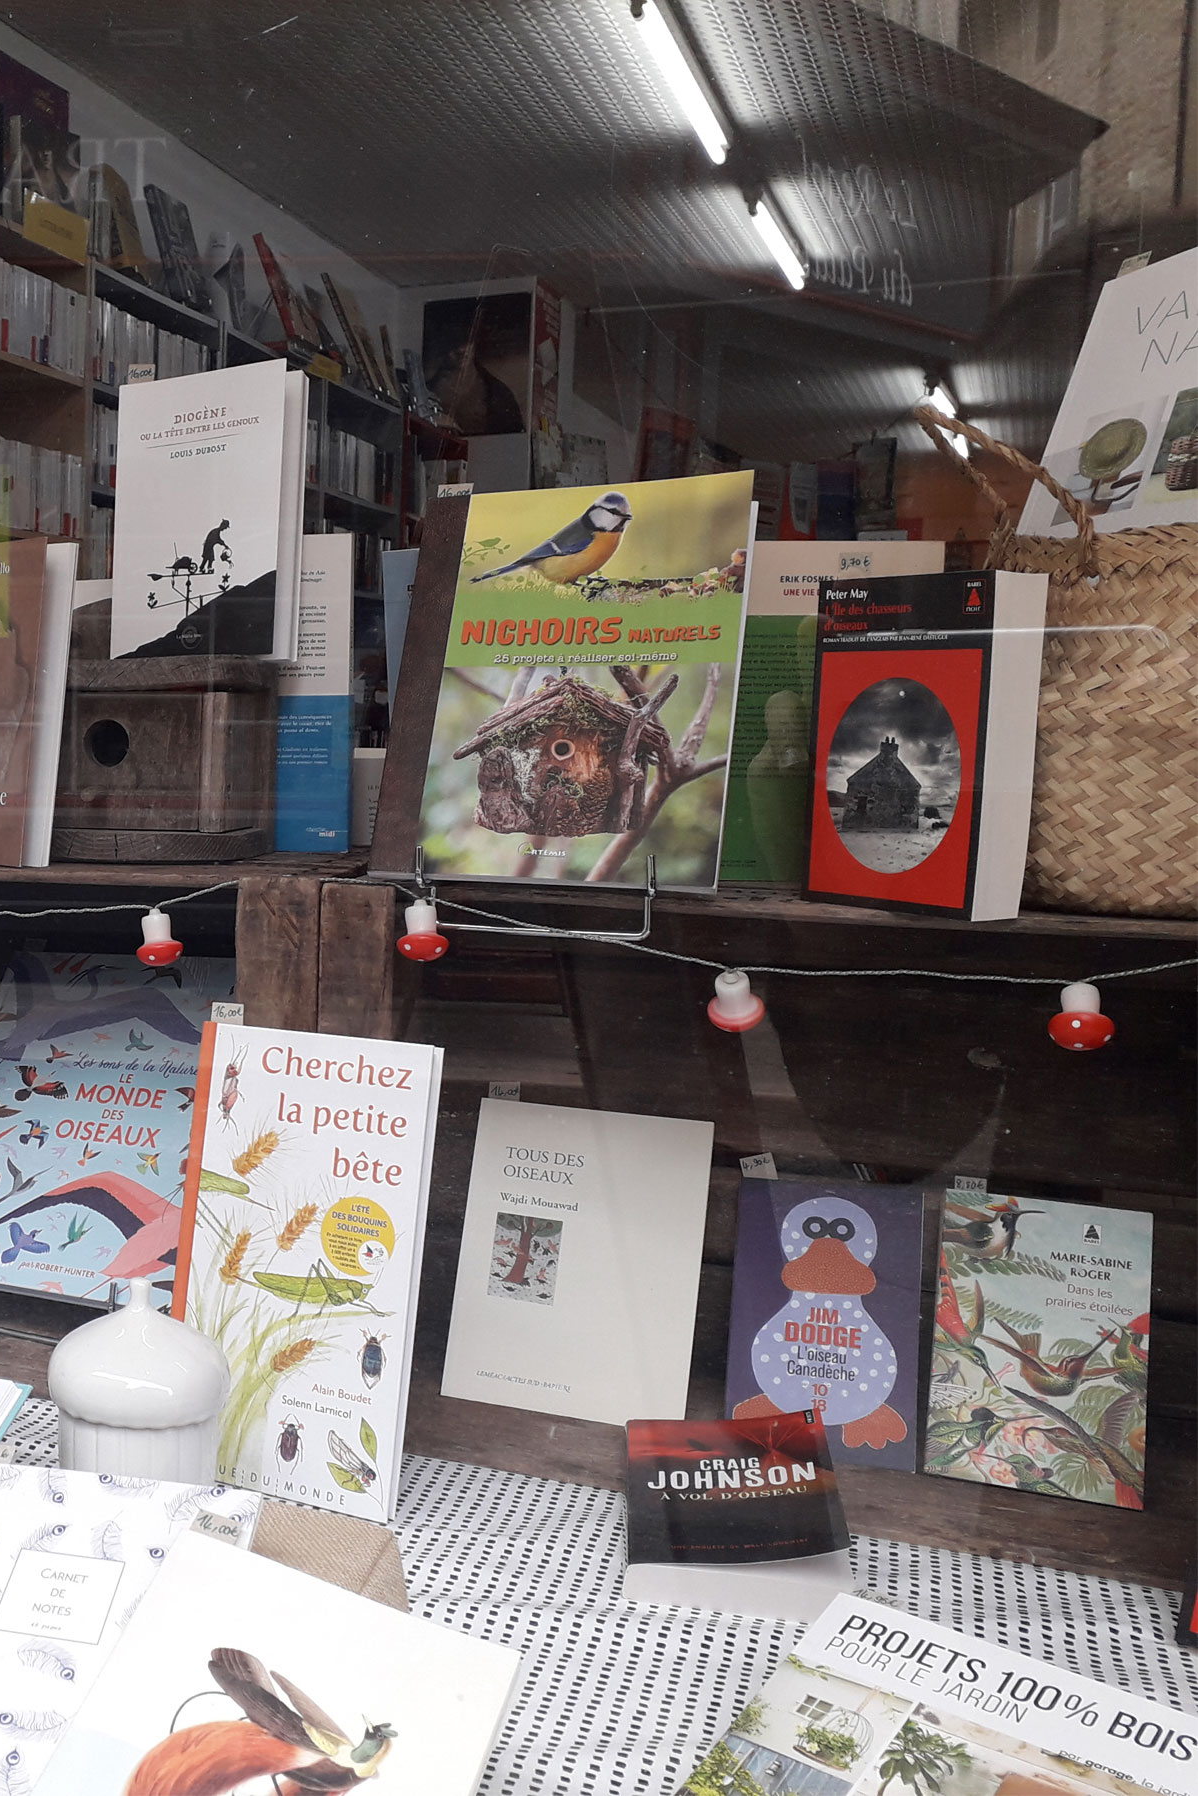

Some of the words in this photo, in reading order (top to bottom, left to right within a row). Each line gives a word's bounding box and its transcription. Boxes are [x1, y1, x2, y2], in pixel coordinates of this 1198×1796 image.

[173, 406, 228, 425] DIOGÈNE
[164, 426, 184, 438] TÊTE
[185, 423, 211, 435] ENTRE
[213, 421, 226, 431] LES
[227, 416, 260, 429] GENOUX
[170, 449, 193, 459] LOUIS
[196, 443, 227, 455] DUBOST
[780, 575, 800, 583] ERIK
[802, 575, 834, 583] FOSNES
[783, 588, 800, 597] UNE
[802, 588, 815, 596] VIE
[826, 589, 847, 600] Peter
[850, 588, 869, 601] May
[848, 603, 864, 615] des
[866, 603, 912, 614] chasseurs
[460, 615, 623, 646] NICHOIRS
[628, 624, 722, 643] NATURELS
[824, 620, 868, 632] d'oiseaux
[512, 653, 555, 665] projets
[567, 652, 614, 663] réaliser
[617, 651, 678, 663] soi-même
[213, 1005, 243, 1019] 16,00€
[261, 1046, 413, 1091] Cherchez
[118, 1072, 133, 1085] LE
[74, 1083, 168, 1110] MONDE
[101, 1108, 125, 1121] DES
[277, 1092, 302, 1125] la
[312, 1104, 408, 1138] petite
[55, 1118, 162, 1148] OISEAUX
[333, 1147, 403, 1186] bête
[505, 1146, 550, 1164] TOUS
[554, 1152, 585, 1168] DES
[503, 1164, 574, 1186] OISEAUX
[351, 1204, 370, 1214] L'ÉTÉ
[500, 1191, 528, 1206] Wajdi
[530, 1196, 579, 1212] Mouawad
[332, 1211, 346, 1220] DES
[348, 1214, 387, 1228] BOUQUINS
[337, 1223, 380, 1238] SOLIDAIRES
[35, 1261, 63, 1276] ROBERT
[63, 1266, 96, 1279] HUNTER
[1050, 1251, 1133, 1271] MARIE-SABINE
[1070, 1266, 1111, 1281] ROGER
[1067, 1283, 1090, 1298] Dans
[1097, 1288, 1113, 1299] les
[807, 1306, 840, 1325] JIM
[1045, 1296, 1087, 1312] prairies
[1089, 1300, 1133, 1317] étoilées
[784, 1321, 862, 1350] DODGE
[796, 1345, 847, 1365] L'oiseau
[786, 1359, 856, 1383] Canadèche
[311, 1384, 335, 1397] Alain
[337, 1388, 372, 1406] Boudet
[812, 1383, 829, 1397] 10
[281, 1394, 312, 1410] Solenn
[315, 1401, 352, 1420] Larnicol
[811, 1398, 828, 1413] 18
[700, 1457, 760, 1470] CRAIG
[647, 1462, 817, 1490] JOHNSON
[283, 1481, 346, 1506] MONDE
[679, 1492, 713, 1500] VOL
[721, 1485, 808, 1500] D'OISEAU
[41, 1568, 88, 1584] CARNET
[50, 1588, 66, 1598] DE
[32, 1603, 71, 1616] NOTES
[824, 1635, 891, 1672] POUR
[895, 1664, 933, 1687] LE
[931, 1674, 1029, 1725] JARDIN
[838, 1614, 988, 1684] PROJETS
[996, 1670, 1100, 1728] 100%
[1107, 1710, 1198, 1762] BOIS
[1085, 1760, 1136, 1784] garage,
